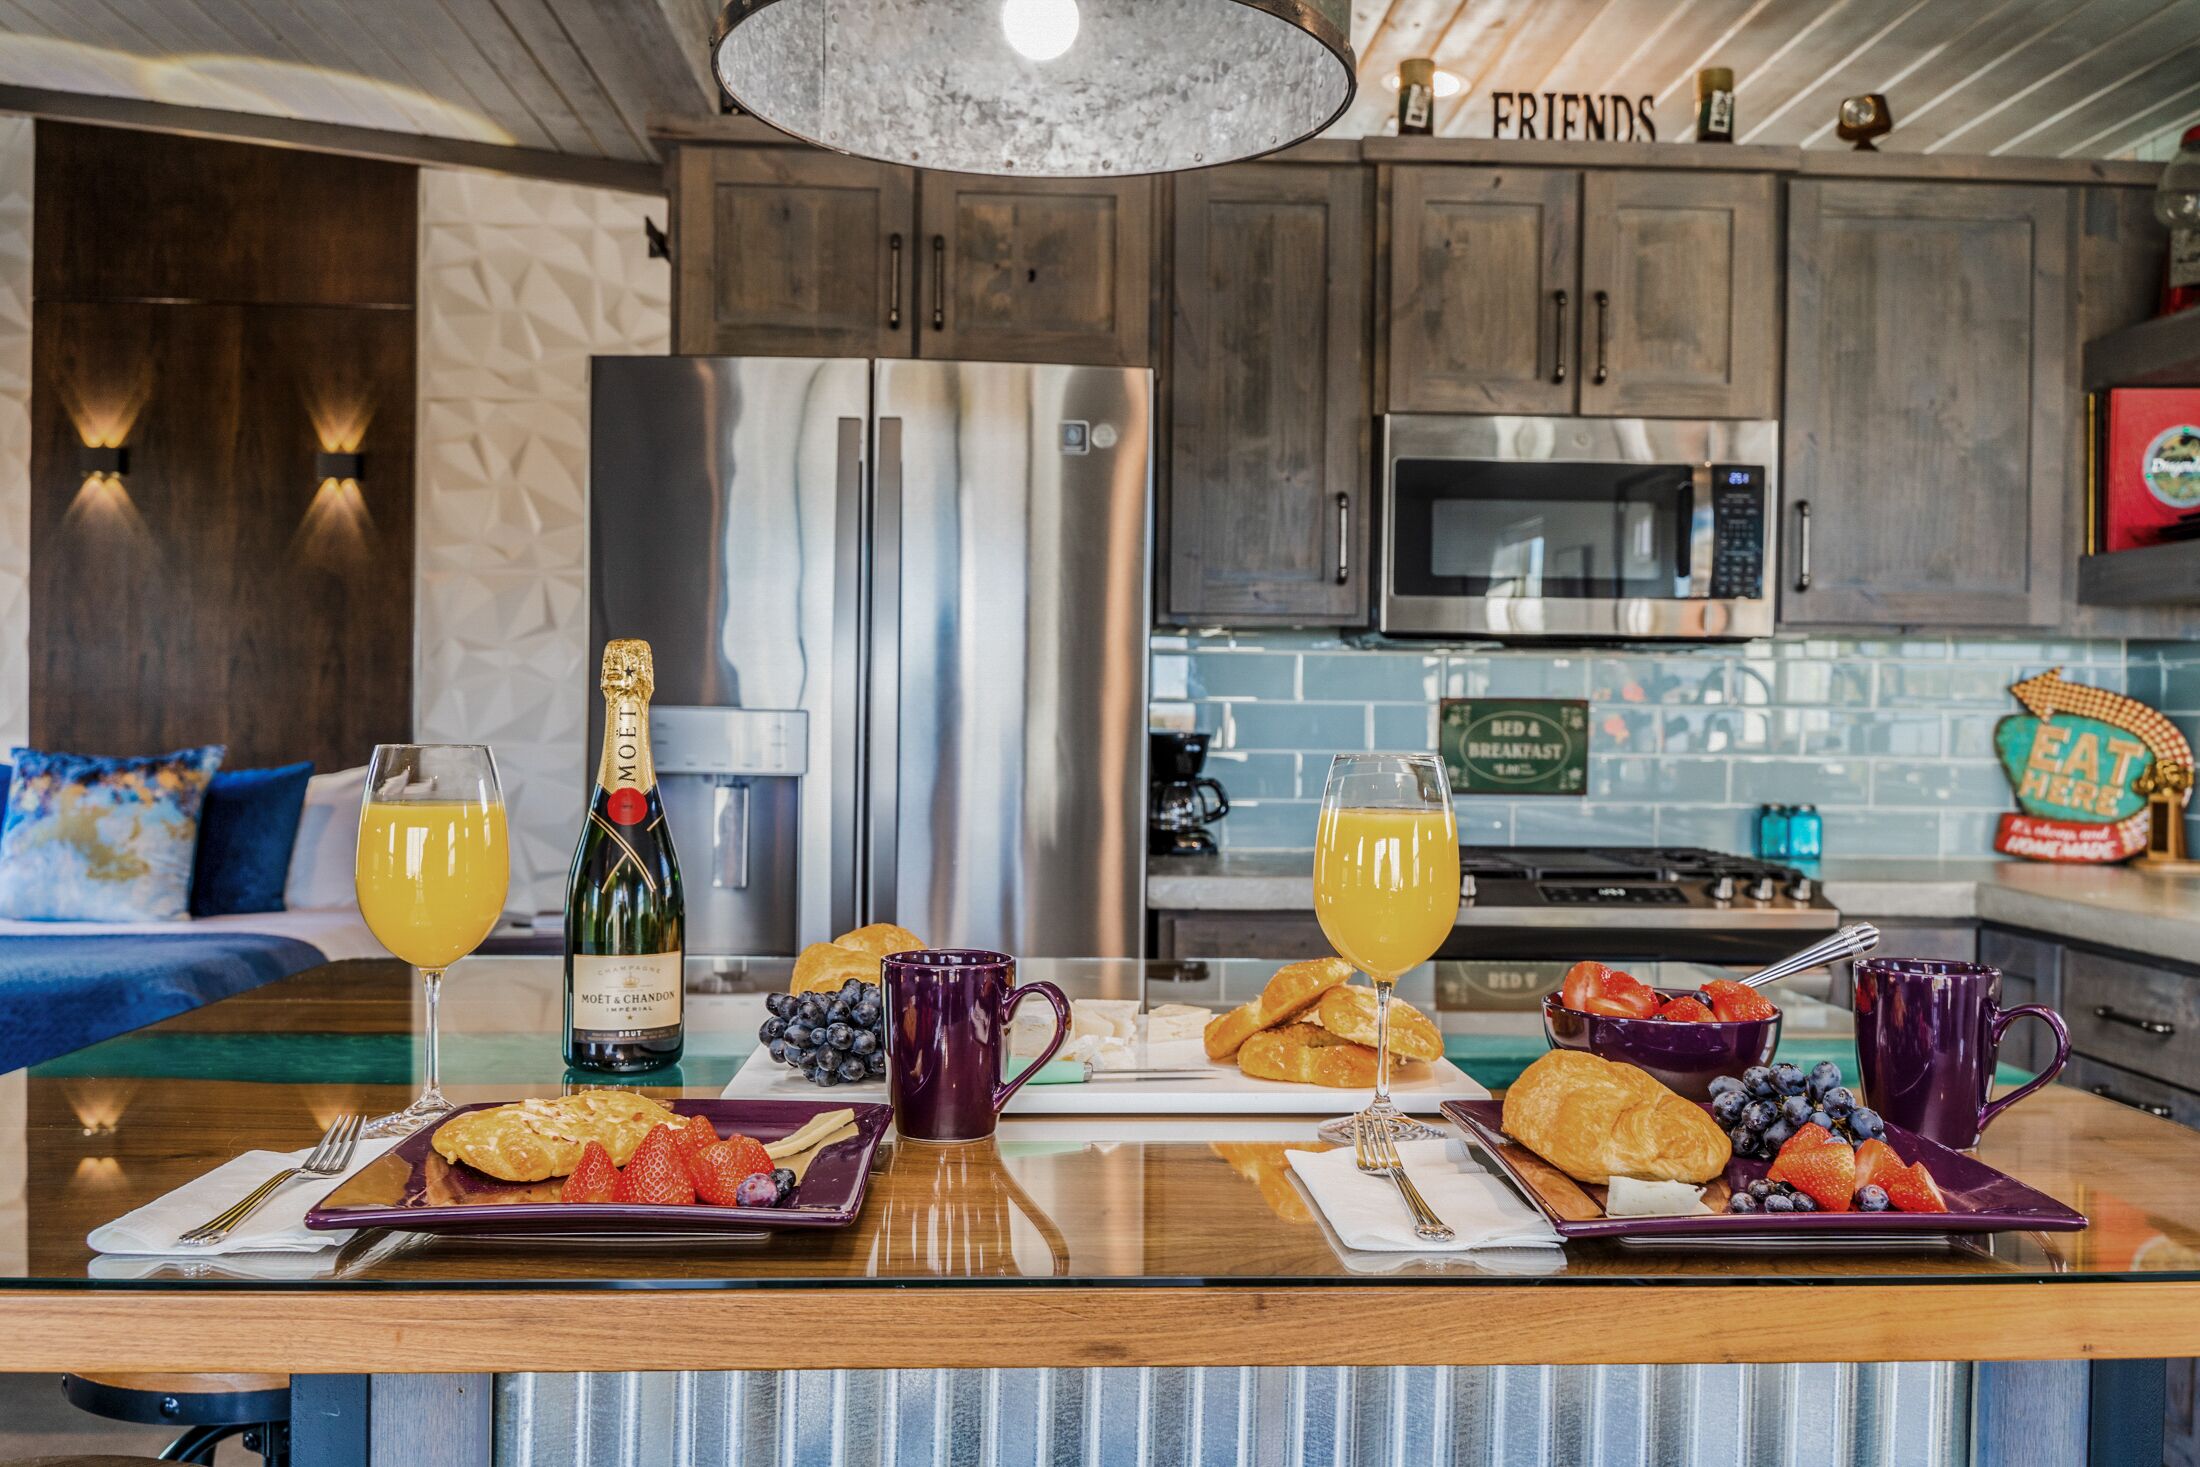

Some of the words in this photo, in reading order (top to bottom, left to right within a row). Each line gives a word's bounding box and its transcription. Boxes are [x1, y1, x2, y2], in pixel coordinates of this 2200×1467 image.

[1491, 92, 1656, 142] FRIENDS
[1491, 720, 1525, 737] BED
[1528, 720, 1541, 737] &
[616, 707, 637, 782] MOËT
[1468, 742, 1563, 760] BREAKFAST
[2028, 725, 2145, 787] EAT
[2017, 771, 2124, 817] HERE
[597, 965, 663, 976] CHAMPAGNE
[623, 991, 676, 1005] CHANDON
[618, 1030, 642, 1038] BRUT
